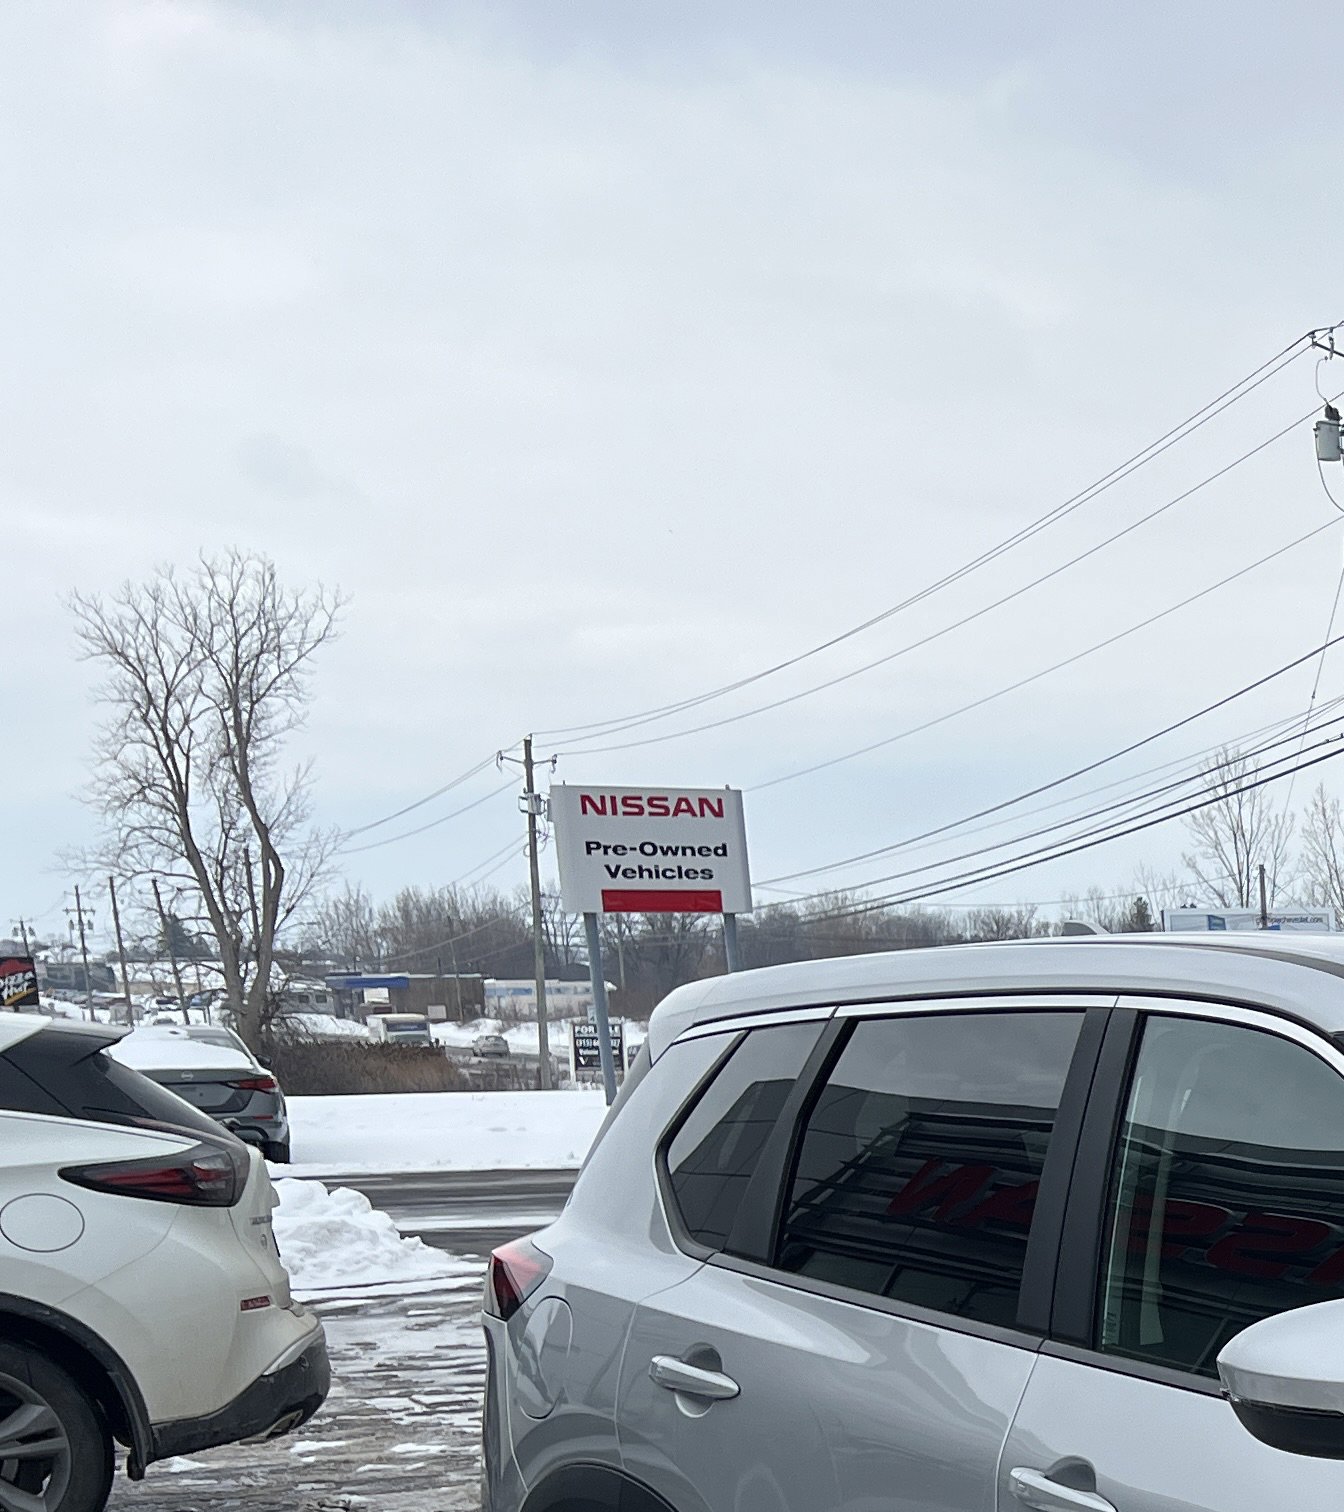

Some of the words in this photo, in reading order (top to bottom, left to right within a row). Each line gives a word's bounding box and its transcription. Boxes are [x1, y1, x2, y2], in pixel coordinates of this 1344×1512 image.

[580, 794, 724, 818] NISSAN
[585, 841, 728, 857] Pre-Owned
[604, 864, 714, 880] Vehicles
